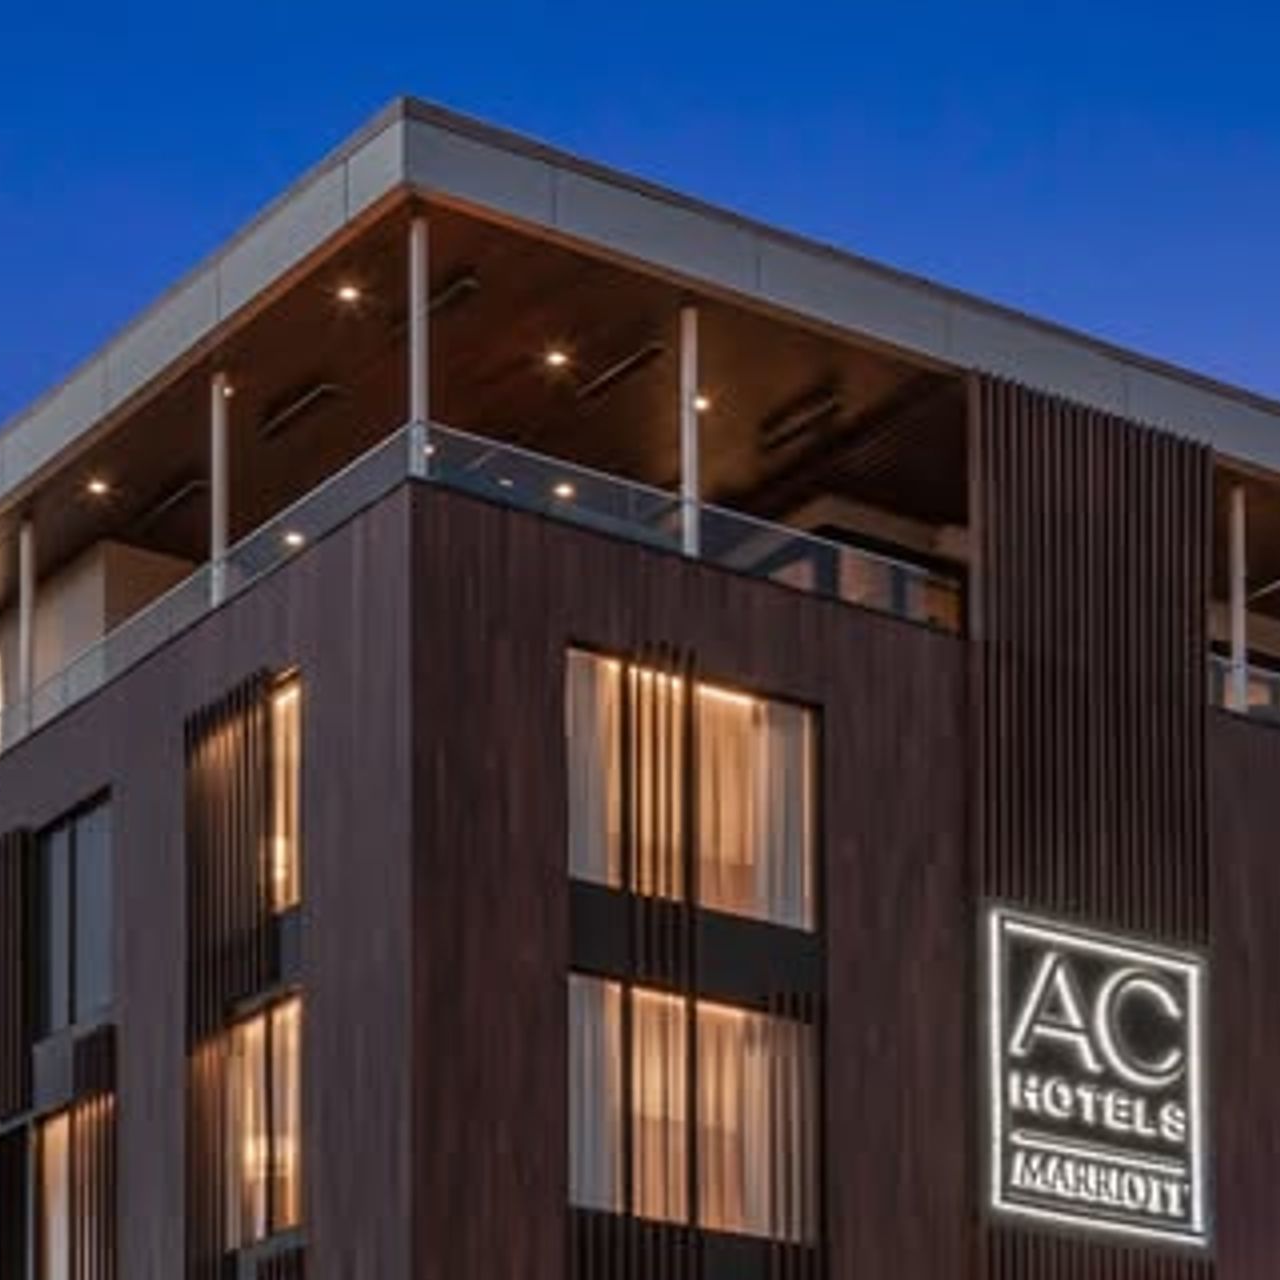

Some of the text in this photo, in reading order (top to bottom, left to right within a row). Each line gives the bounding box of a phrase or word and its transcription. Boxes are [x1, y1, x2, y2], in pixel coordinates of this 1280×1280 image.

[1008, 951, 1185, 1087] AC
[1008, 1071, 1186, 1141] HOTELS
[1010, 1150, 1190, 1217] MARRIOTT
